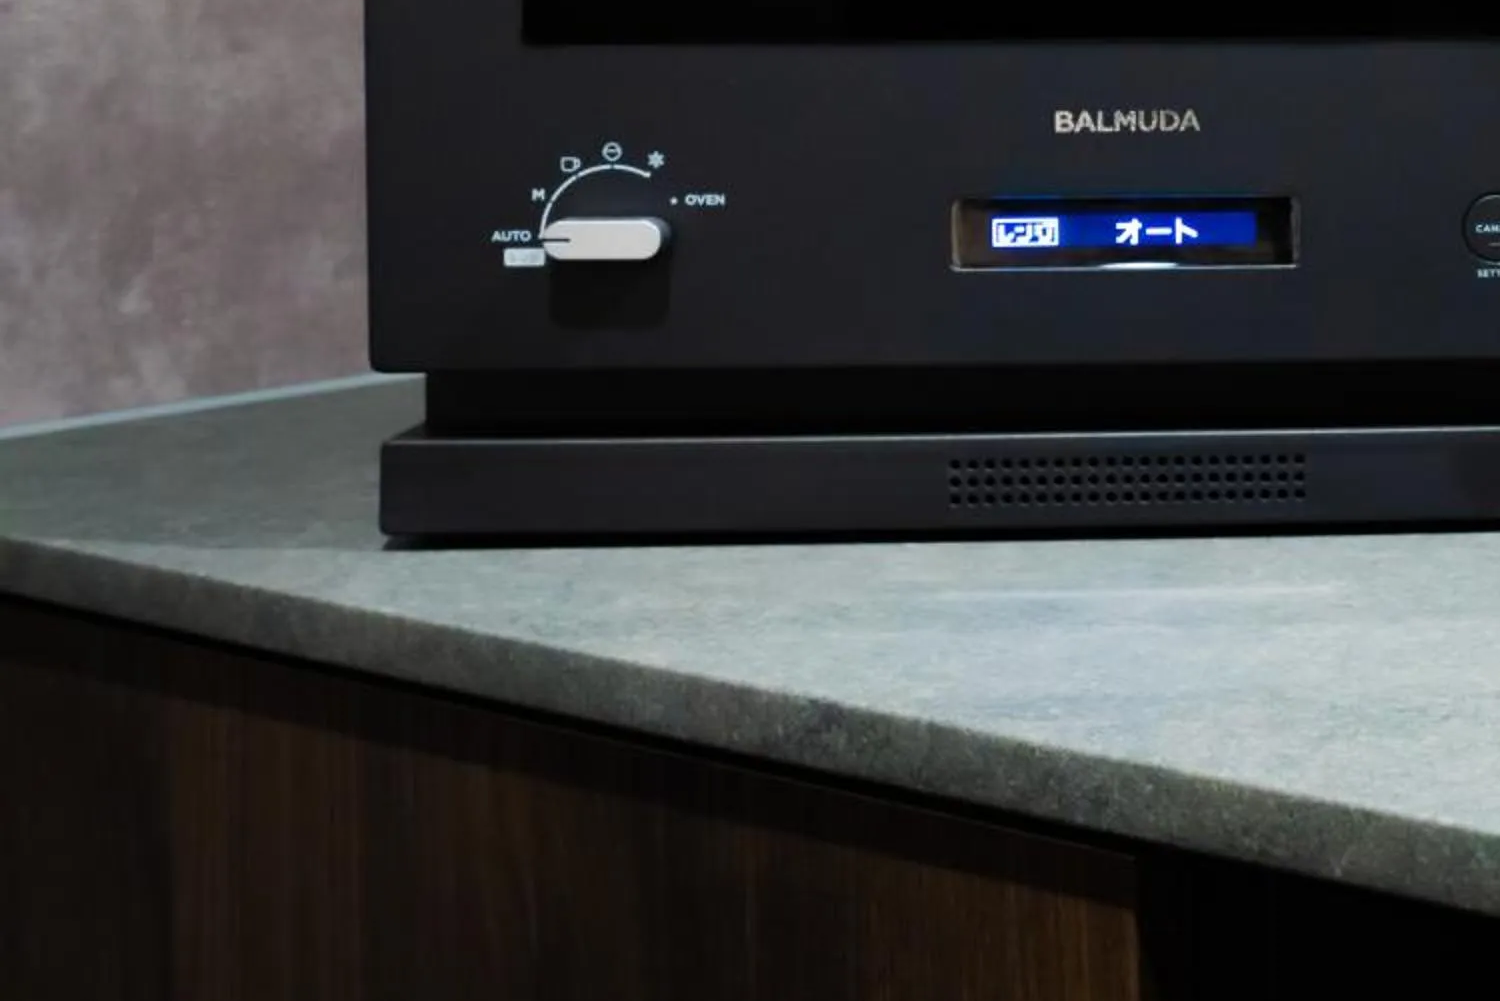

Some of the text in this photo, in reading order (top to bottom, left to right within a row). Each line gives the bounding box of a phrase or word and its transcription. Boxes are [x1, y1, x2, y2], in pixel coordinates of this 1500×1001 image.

[1054, 109, 1201, 134] BALMUDA
[531, 187, 546, 202] M
[684, 193, 726, 207] OVEN
[491, 229, 532, 243] AUTO
[1115, 216, 1199, 246] オート
